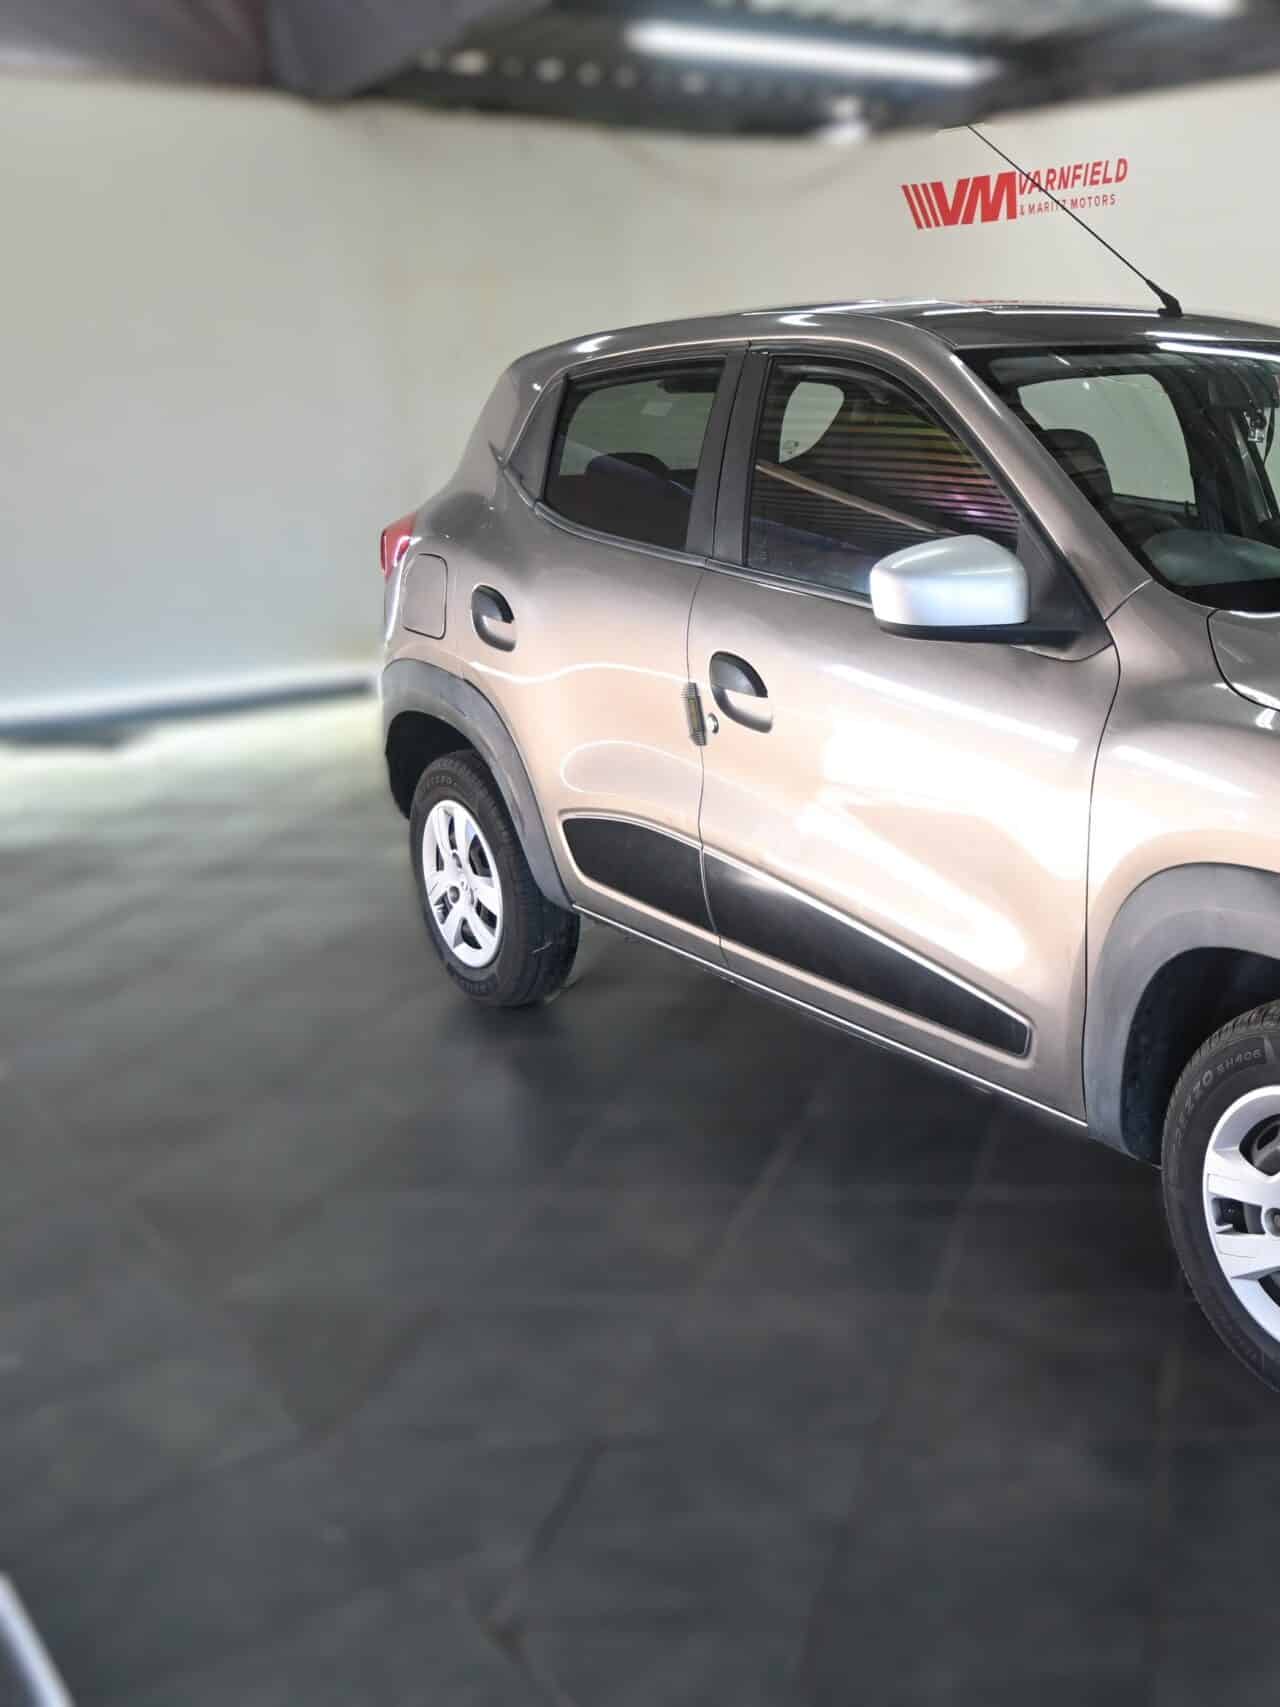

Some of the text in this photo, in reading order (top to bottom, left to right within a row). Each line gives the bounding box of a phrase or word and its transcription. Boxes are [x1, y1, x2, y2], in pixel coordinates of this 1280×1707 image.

[1018, 158, 1128, 195] VARNFIELD
[930, 171, 1017, 226] VM
[1070, 193, 1117, 210] MOTORS
